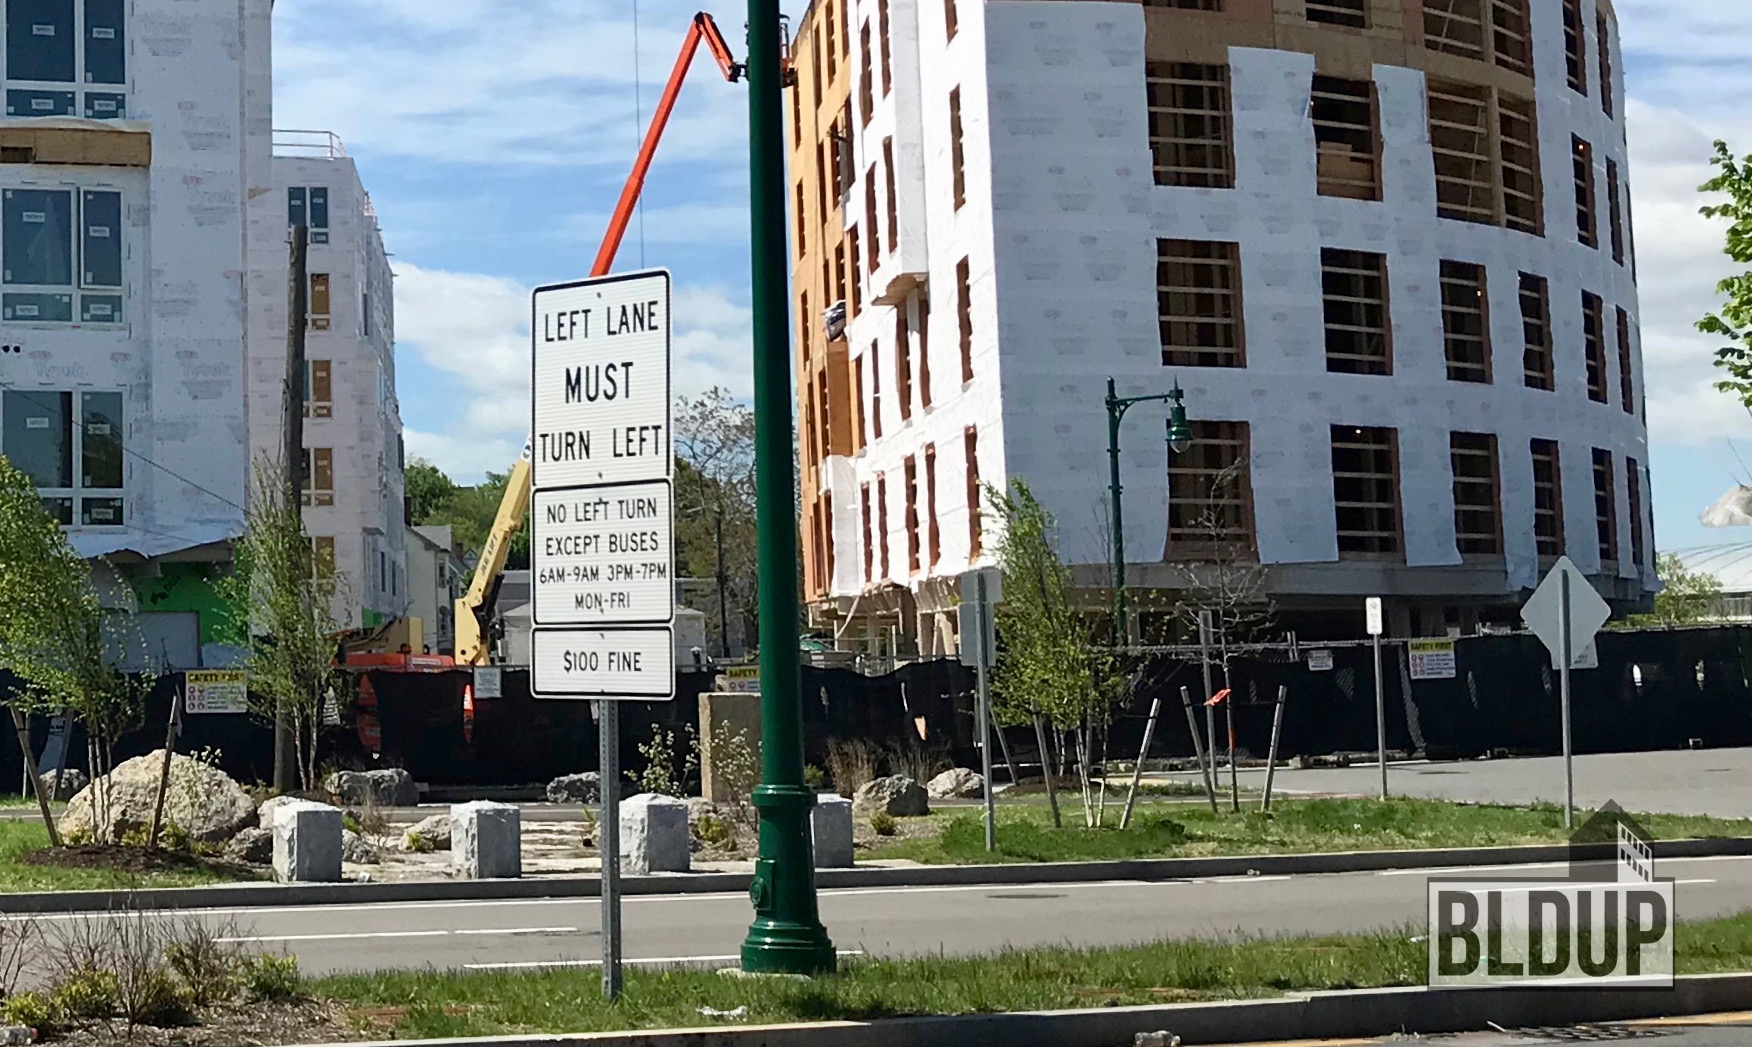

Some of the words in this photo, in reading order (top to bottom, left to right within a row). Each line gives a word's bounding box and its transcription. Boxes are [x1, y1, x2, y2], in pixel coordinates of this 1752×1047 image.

[545, 308, 591, 342] LEFT
[606, 300, 658, 335] LANE
[565, 361, 634, 404] MUST
[540, 430, 590, 462] TURN
[613, 425, 662, 458] LEFT
[547, 504, 567, 524] NO
[575, 501, 609, 522] LEFT
[618, 497, 657, 520] TURN
[546, 535, 600, 556] EXCEPT
[609, 531, 659, 553] BUSES
[539, 565, 599, 584] 6AM-9AM
[607, 562, 667, 582] 3PM-7PM
[575, 592, 631, 610] MON-FRI
[563, 650, 599, 673] $100
[608, 651, 642, 672] FINE
